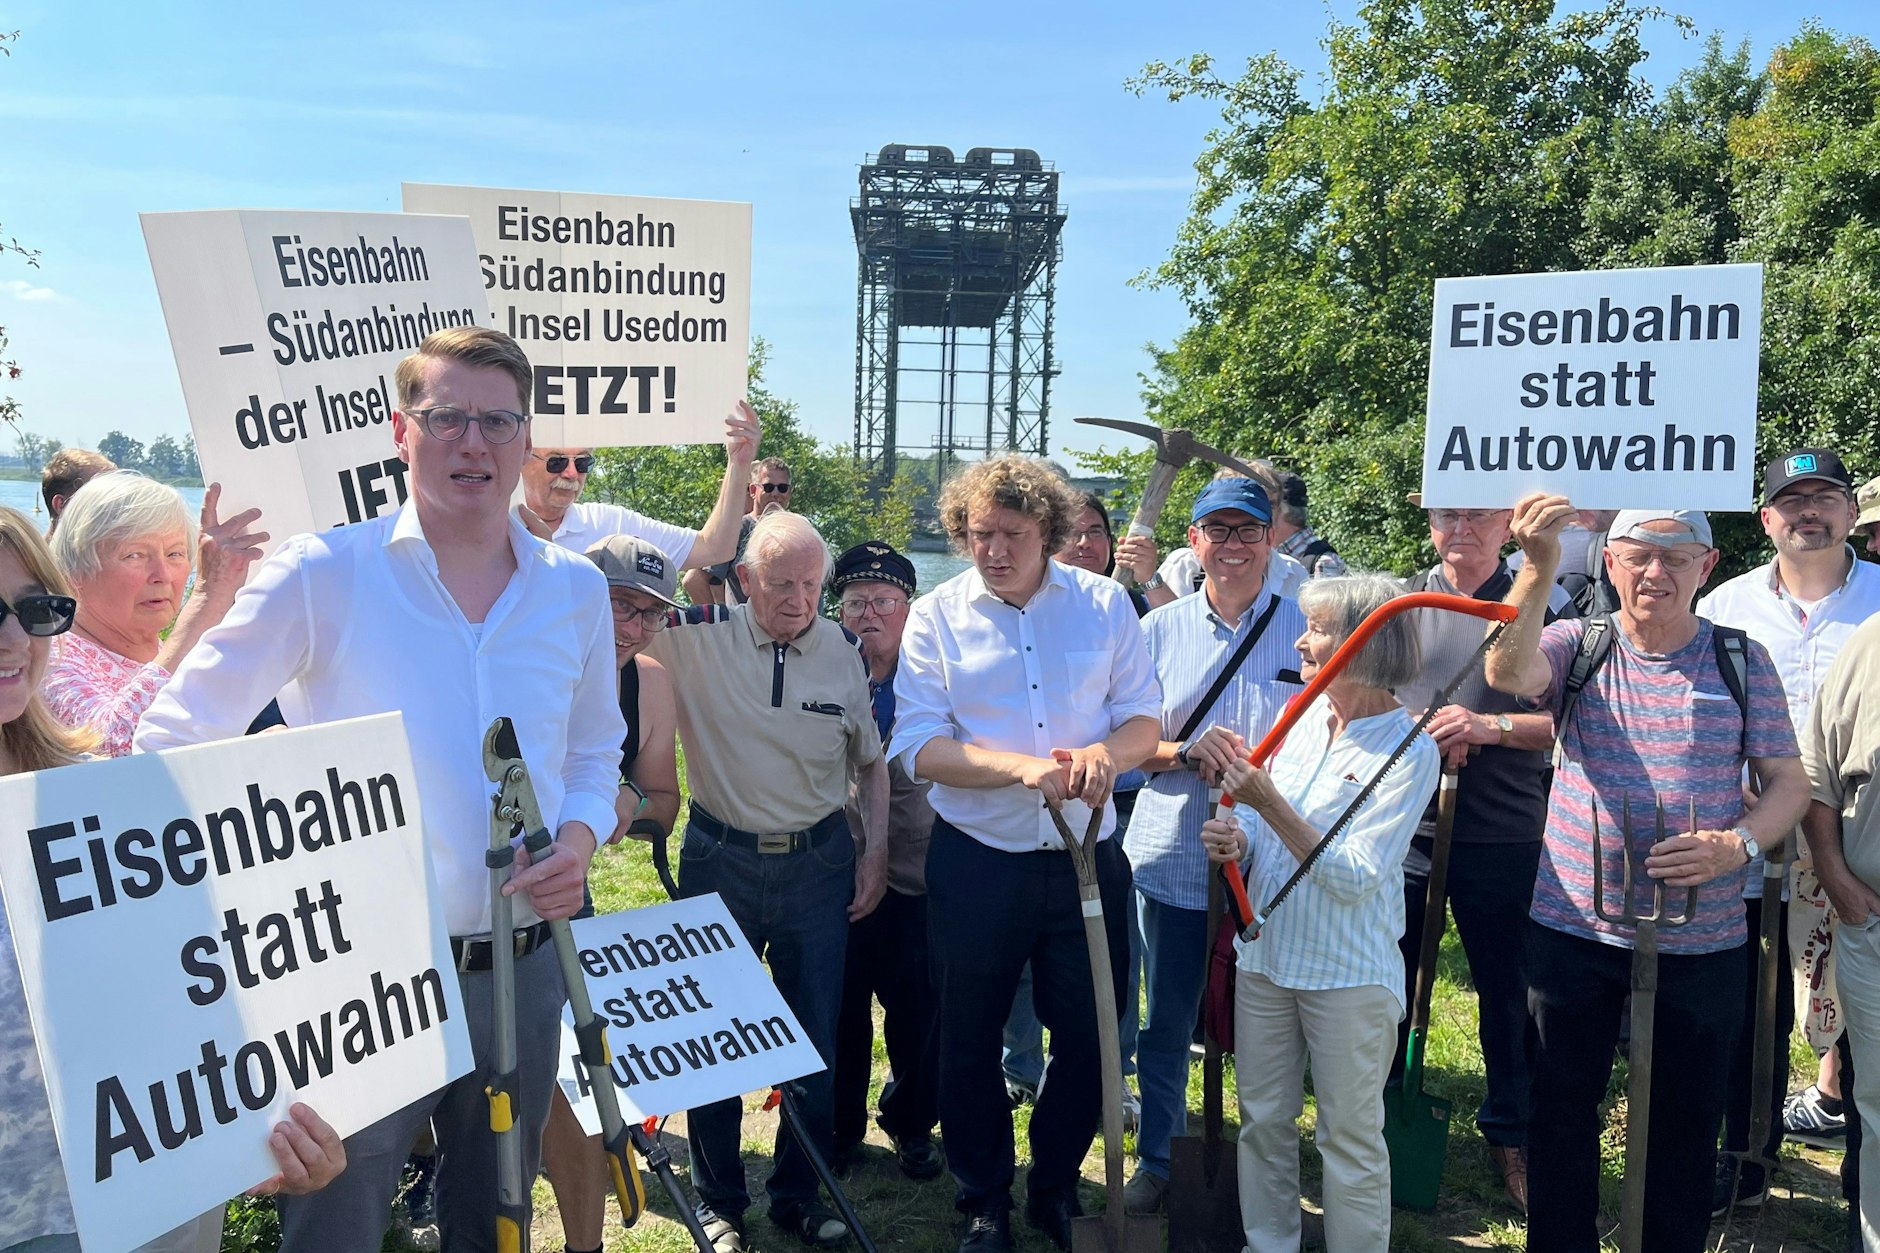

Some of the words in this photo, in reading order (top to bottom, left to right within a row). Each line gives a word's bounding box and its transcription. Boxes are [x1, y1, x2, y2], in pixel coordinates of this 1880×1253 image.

[498, 205, 675, 248] Eisenbahn
[272, 235, 429, 288] Eisenbahn
[479, 254, 725, 304] Südanbindung
[508, 305, 590, 343] Insel
[603, 309, 727, 343] Usedom
[1450, 294, 1740, 348] Eisenbahn
[533, 365, 676, 415] ETZT!
[1520, 360, 1657, 409] statt
[235, 395, 307, 450] der
[315, 375, 392, 435] Insel
[1437, 423, 1736, 472] Autowahn
[27, 766, 407, 923] Eisenbahn
[180, 879, 352, 1007] statt
[577, 922, 736, 978] enbahn
[603, 974, 713, 1029] statt
[94, 966, 449, 1184] Autowahn
